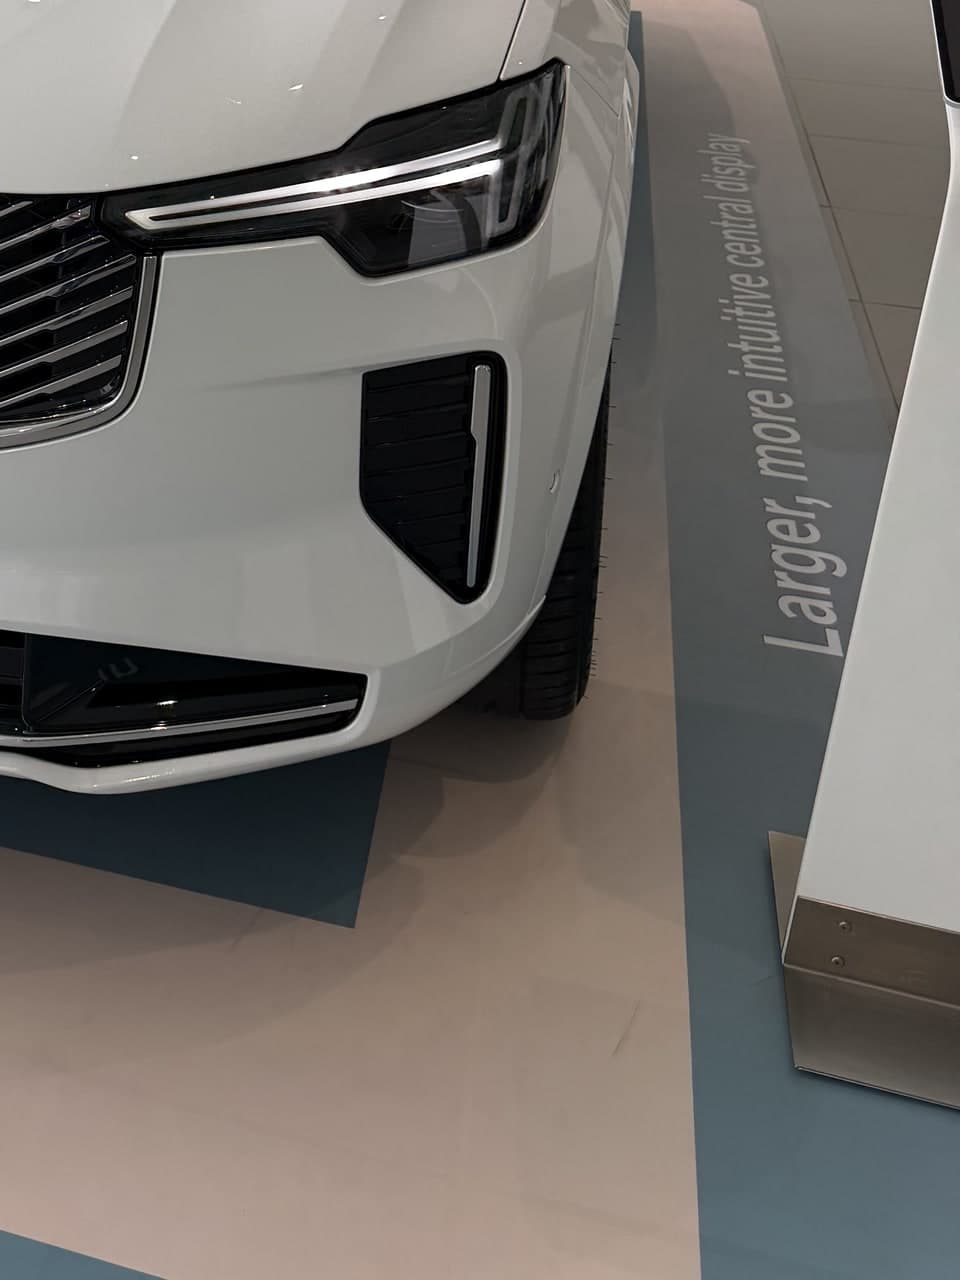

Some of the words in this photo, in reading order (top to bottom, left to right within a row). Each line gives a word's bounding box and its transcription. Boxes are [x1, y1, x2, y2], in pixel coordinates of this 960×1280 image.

[696, 131, 756, 193] display
[703, 194, 765, 267] central
[718, 272, 788, 381] intuitive
[747, 388, 808, 482] more
[763, 494, 847, 658] Larger,
